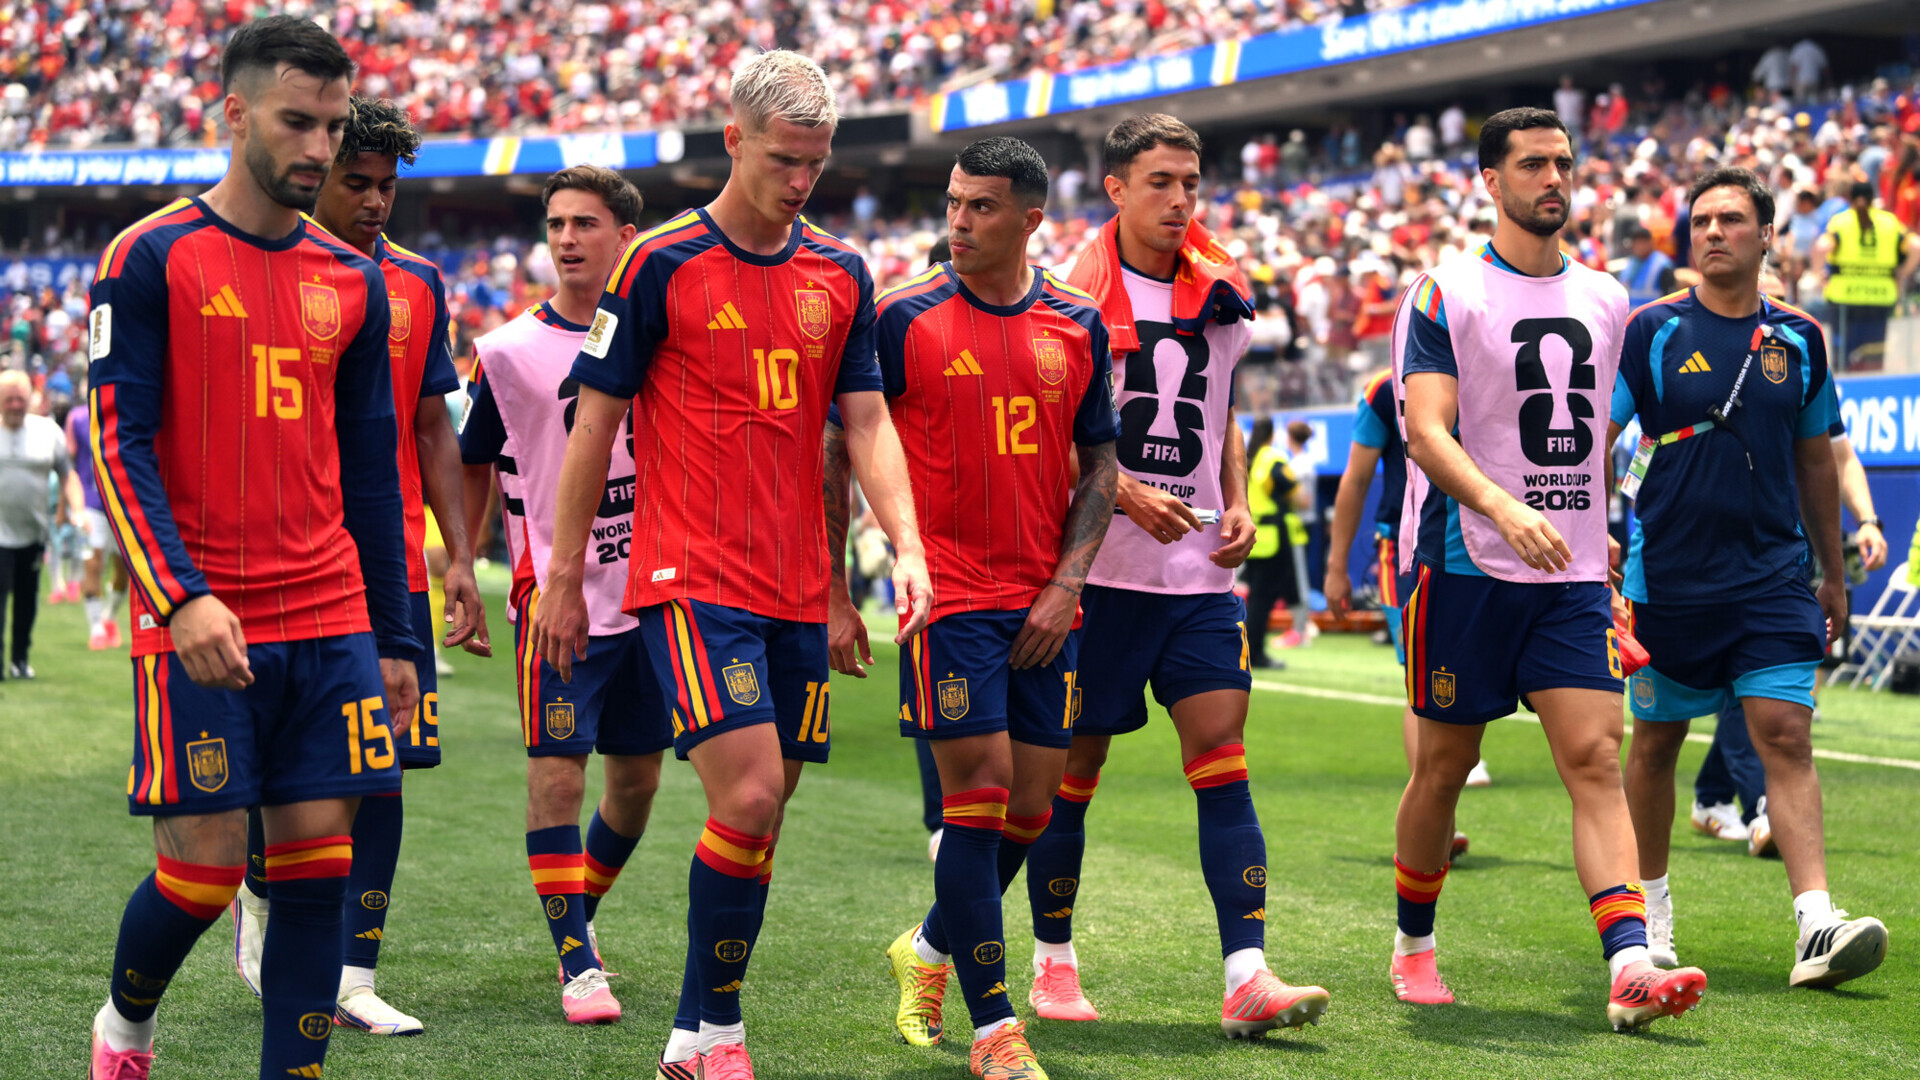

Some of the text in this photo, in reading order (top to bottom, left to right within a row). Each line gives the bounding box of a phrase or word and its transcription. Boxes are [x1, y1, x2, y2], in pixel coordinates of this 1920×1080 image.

[252, 344, 303, 419] 15
[753, 348, 799, 410] 10
[1734, 368, 1747, 390] WORLD
[992, 396, 1038, 455] 12
[1836, 385, 1898, 453] ons
[1142, 443, 1181, 463] FIFA
[1547, 437, 1576, 453] FIFA
[608, 482, 636, 503] FIF
[1170, 484, 1195, 498] CUP
[1523, 473, 1572, 487] WORLD
[1524, 489, 1591, 511] 2026
[591, 520, 633, 541] WORL
[596, 537, 632, 565] 20
[797, 681, 831, 743] 10
[1063, 670, 1077, 729] 1
[341, 696, 395, 775] 15
